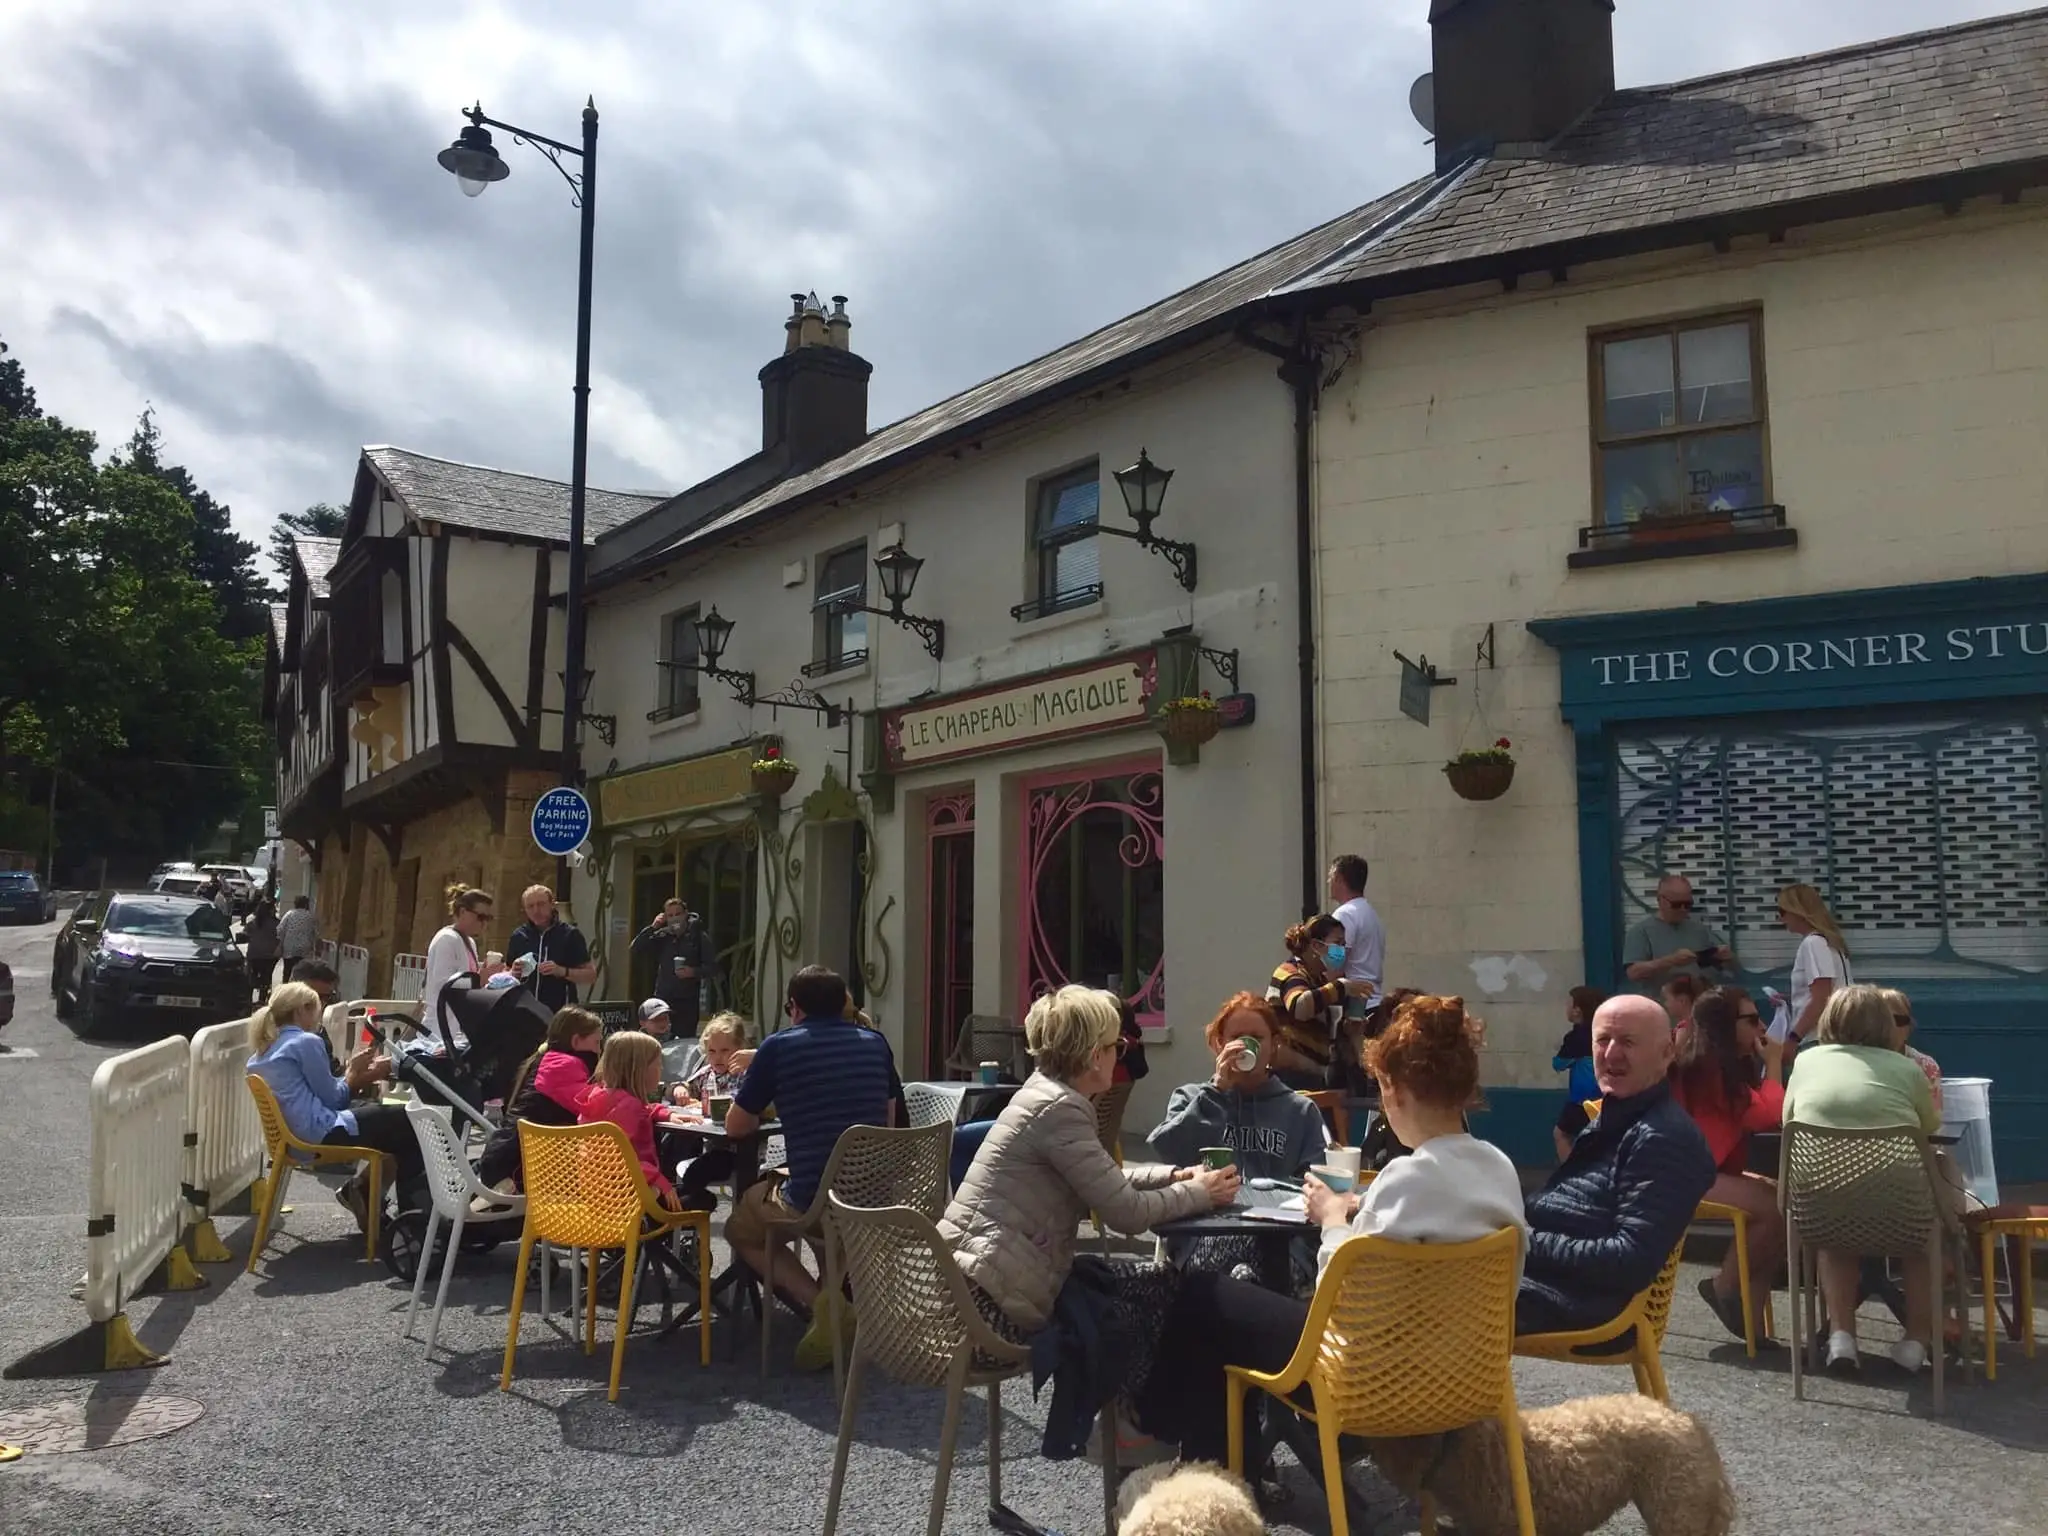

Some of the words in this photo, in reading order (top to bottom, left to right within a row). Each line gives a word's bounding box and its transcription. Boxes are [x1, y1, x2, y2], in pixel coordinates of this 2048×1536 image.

[1591, 650, 1691, 685] THE
[1707, 632, 1931, 678] CORNER
[910, 721, 930, 746] LE
[934, 702, 1017, 744] CHAPEAU
[1032, 677, 1130, 726] MAGIQUE
[548, 795, 577, 806] FREE
[537, 808, 586, 821] PARKING
[544, 830, 557, 838] Car
[558, 830, 575, 838] Park
